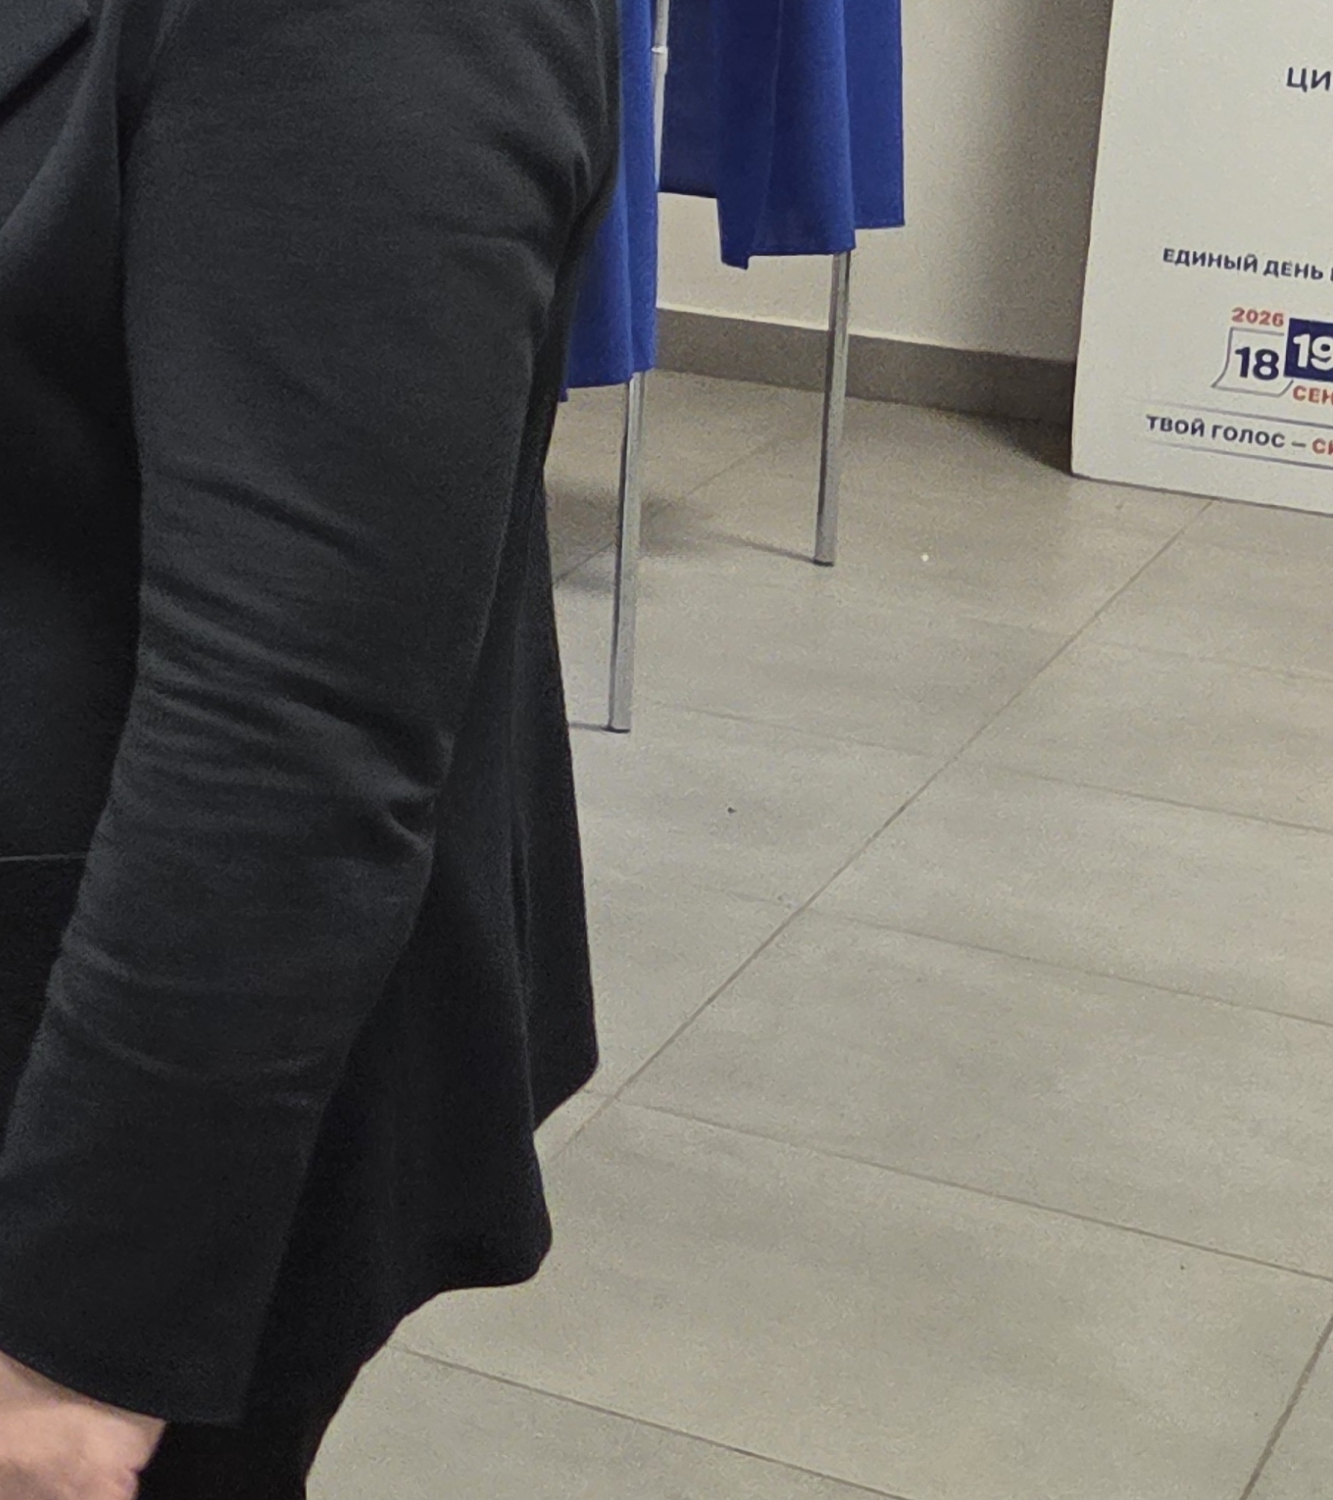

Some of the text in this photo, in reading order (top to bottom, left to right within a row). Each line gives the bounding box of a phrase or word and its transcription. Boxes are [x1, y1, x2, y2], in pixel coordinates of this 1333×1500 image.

[1163, 247, 1324, 281] ЕДИНЫЙ ДЕНЬ
[1231, 307, 1284, 328] 2026
[1235, 333, 1333, 381] 18 19
[1146, 414, 1205, 438] ТВОЙ
[1211, 424, 1286, 449] ГОЛОС
